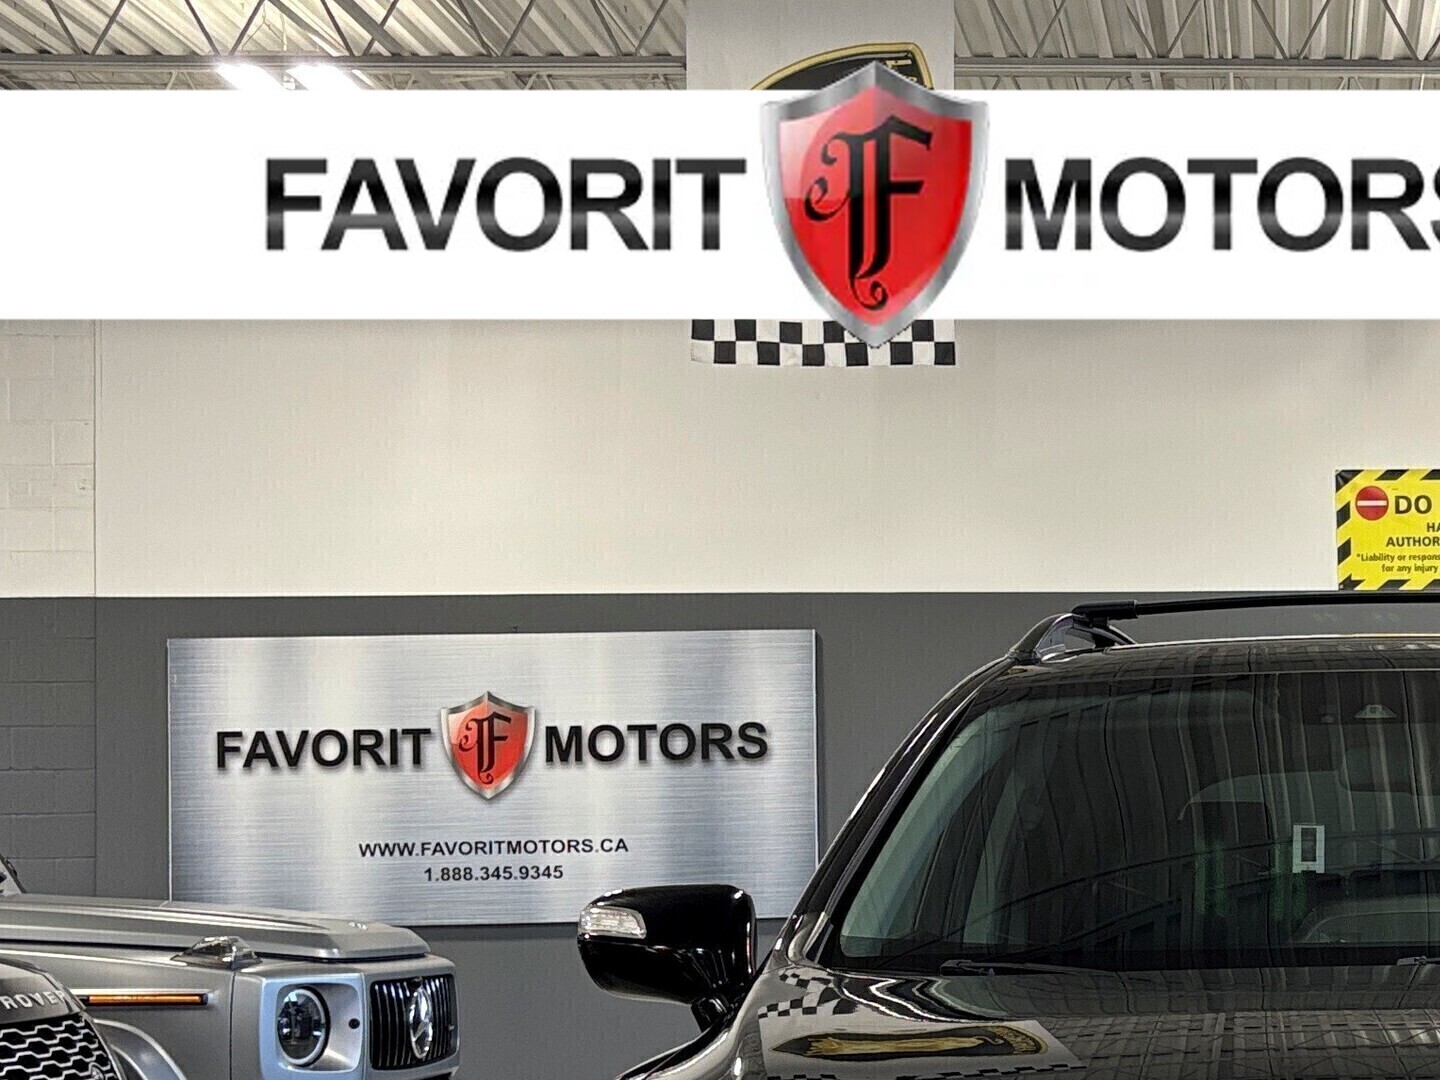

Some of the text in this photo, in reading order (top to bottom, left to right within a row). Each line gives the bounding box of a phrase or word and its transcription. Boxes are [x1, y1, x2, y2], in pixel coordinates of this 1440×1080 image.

[1394, 494, 1432, 515] DO
[1382, 564, 1394, 572] for
[1397, 565, 1411, 574] any
[1414, 563, 1438, 574] injury
[215, 727, 431, 769] FAVORIT
[544, 721, 768, 764] MOTORS
[359, 838, 629, 857] WWW.FAVORITMOTORS.CA
[424, 865, 564, 882] 1.888.345.9345
